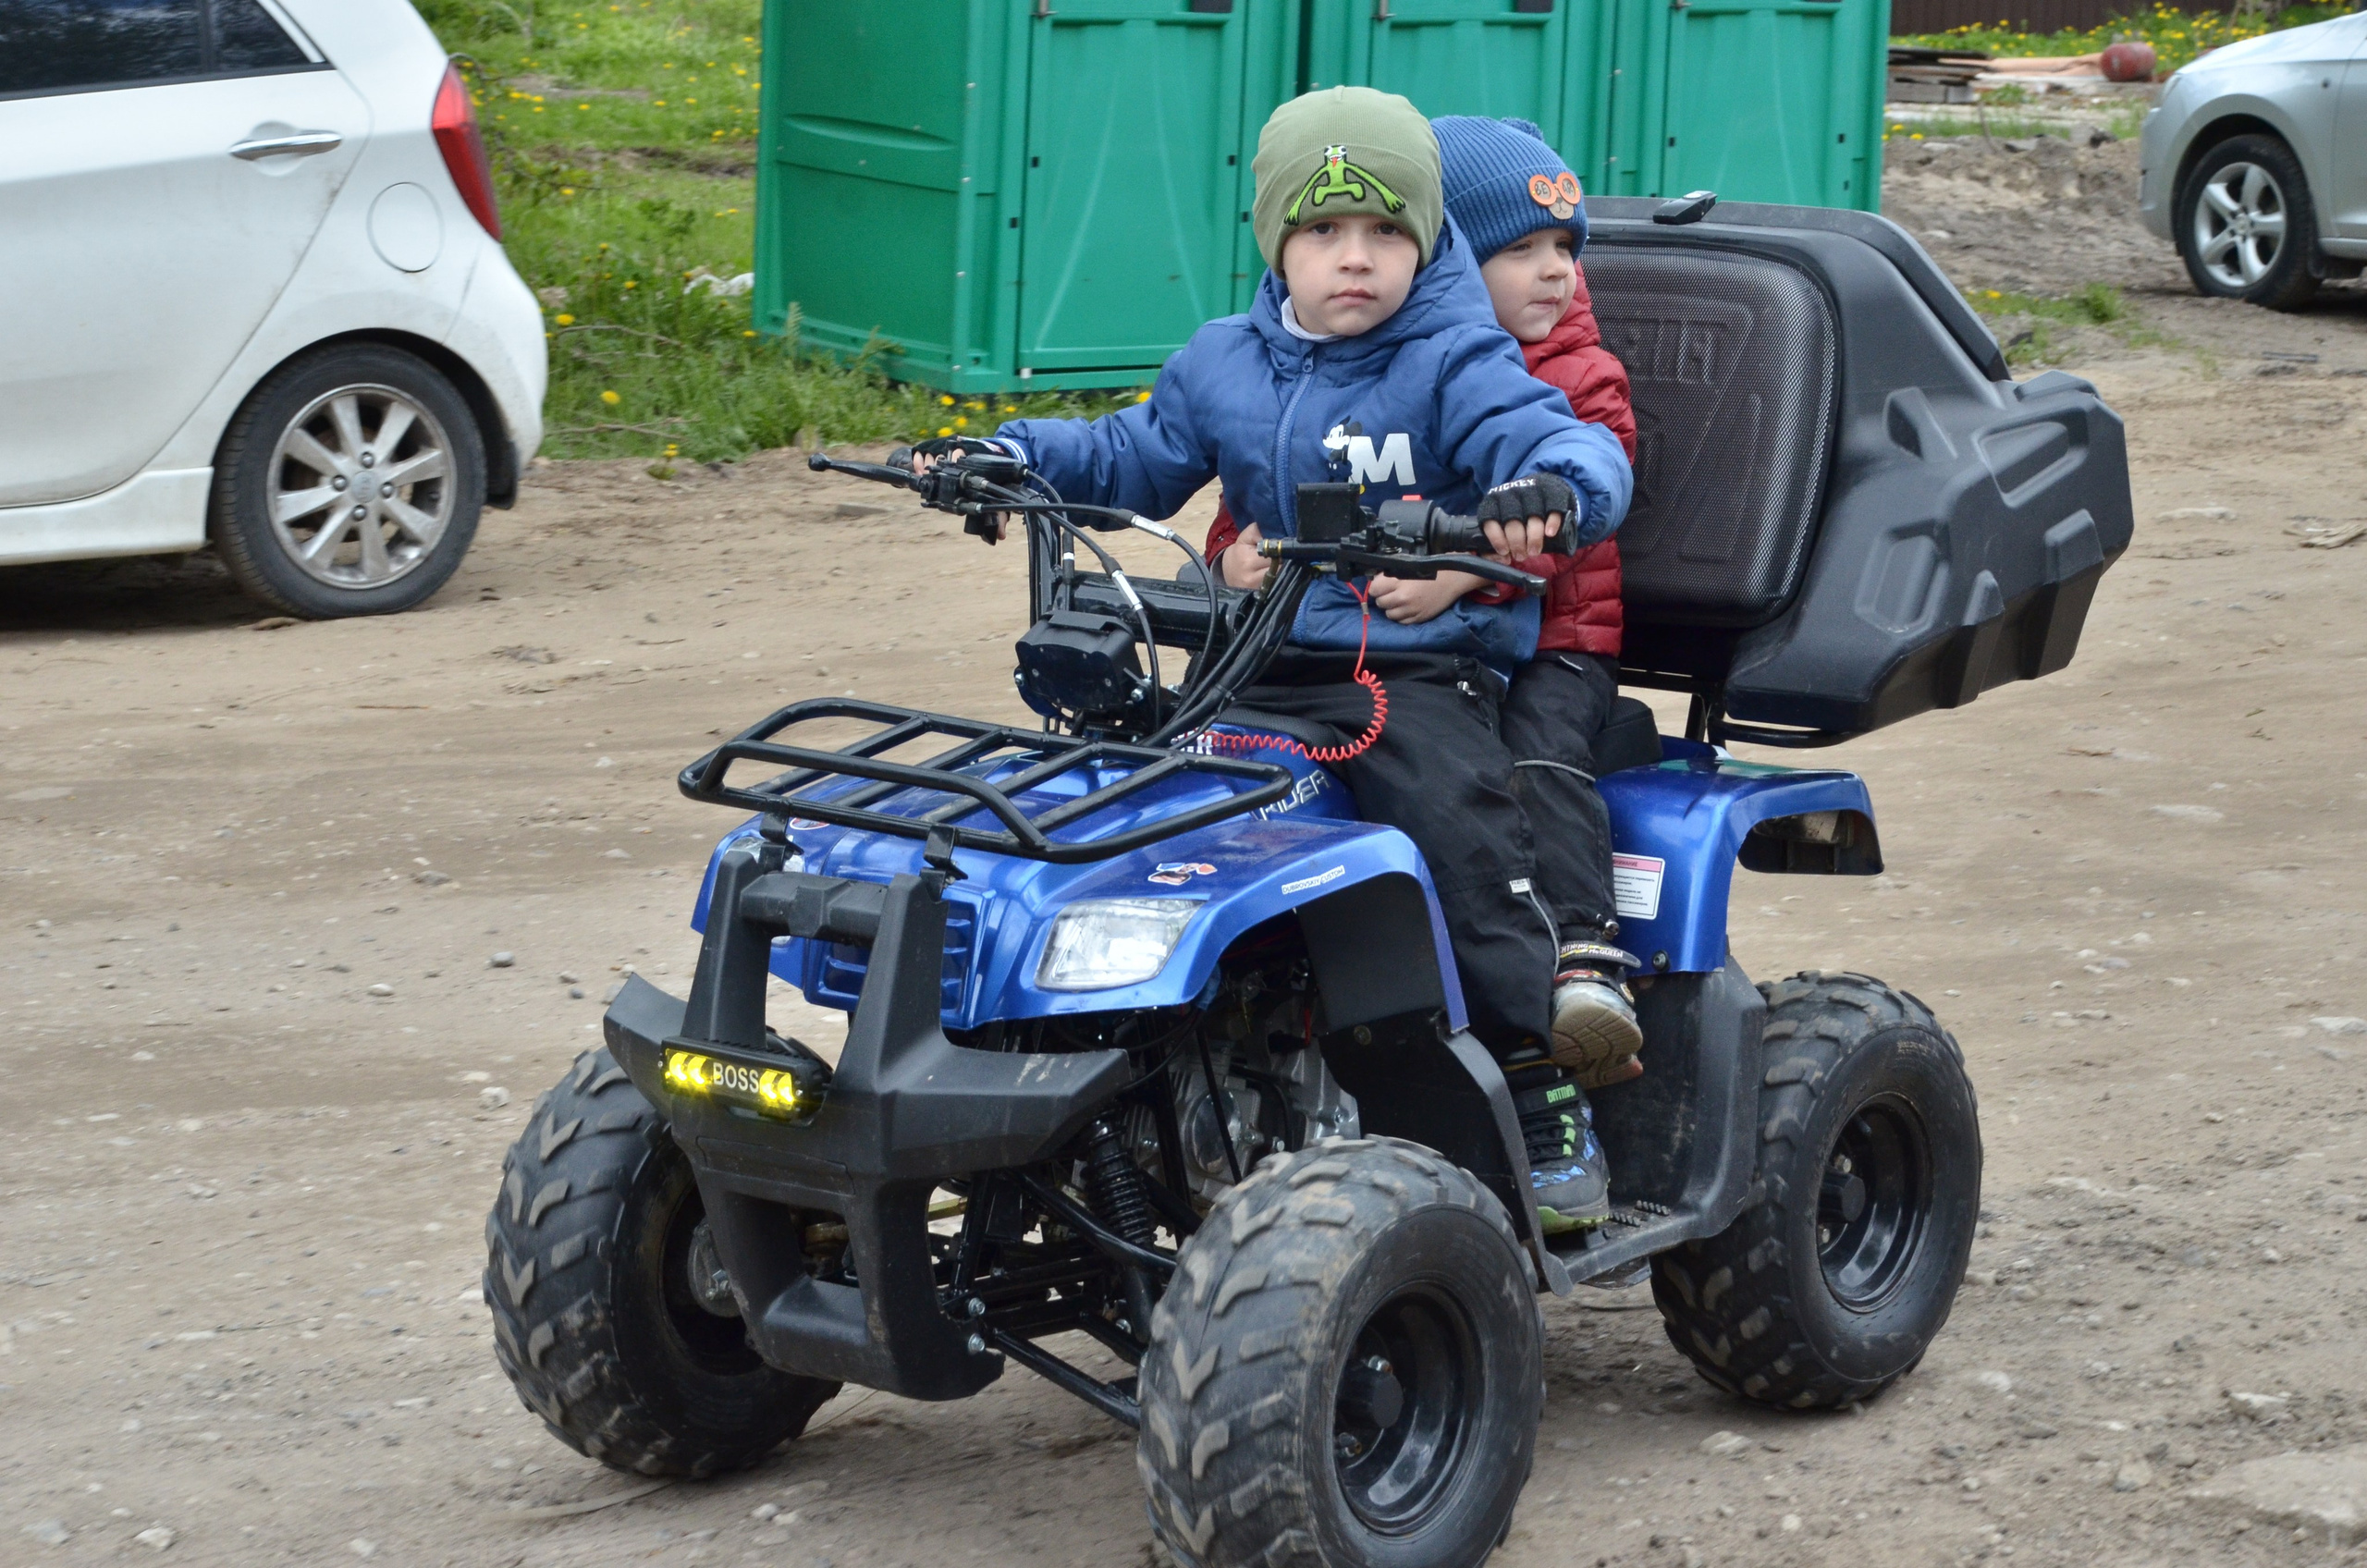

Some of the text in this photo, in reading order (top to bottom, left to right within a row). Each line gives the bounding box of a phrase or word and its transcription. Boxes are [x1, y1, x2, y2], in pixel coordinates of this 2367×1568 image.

[1535, 183, 1548, 196] BE
[1347, 433, 1417, 486] M
[1488, 478, 1536, 496] MICKEY
[1320, 868, 1343, 883] CUSTOM
[1561, 943, 1588, 955] HTNING
[712, 1061, 760, 1094] BOSS
